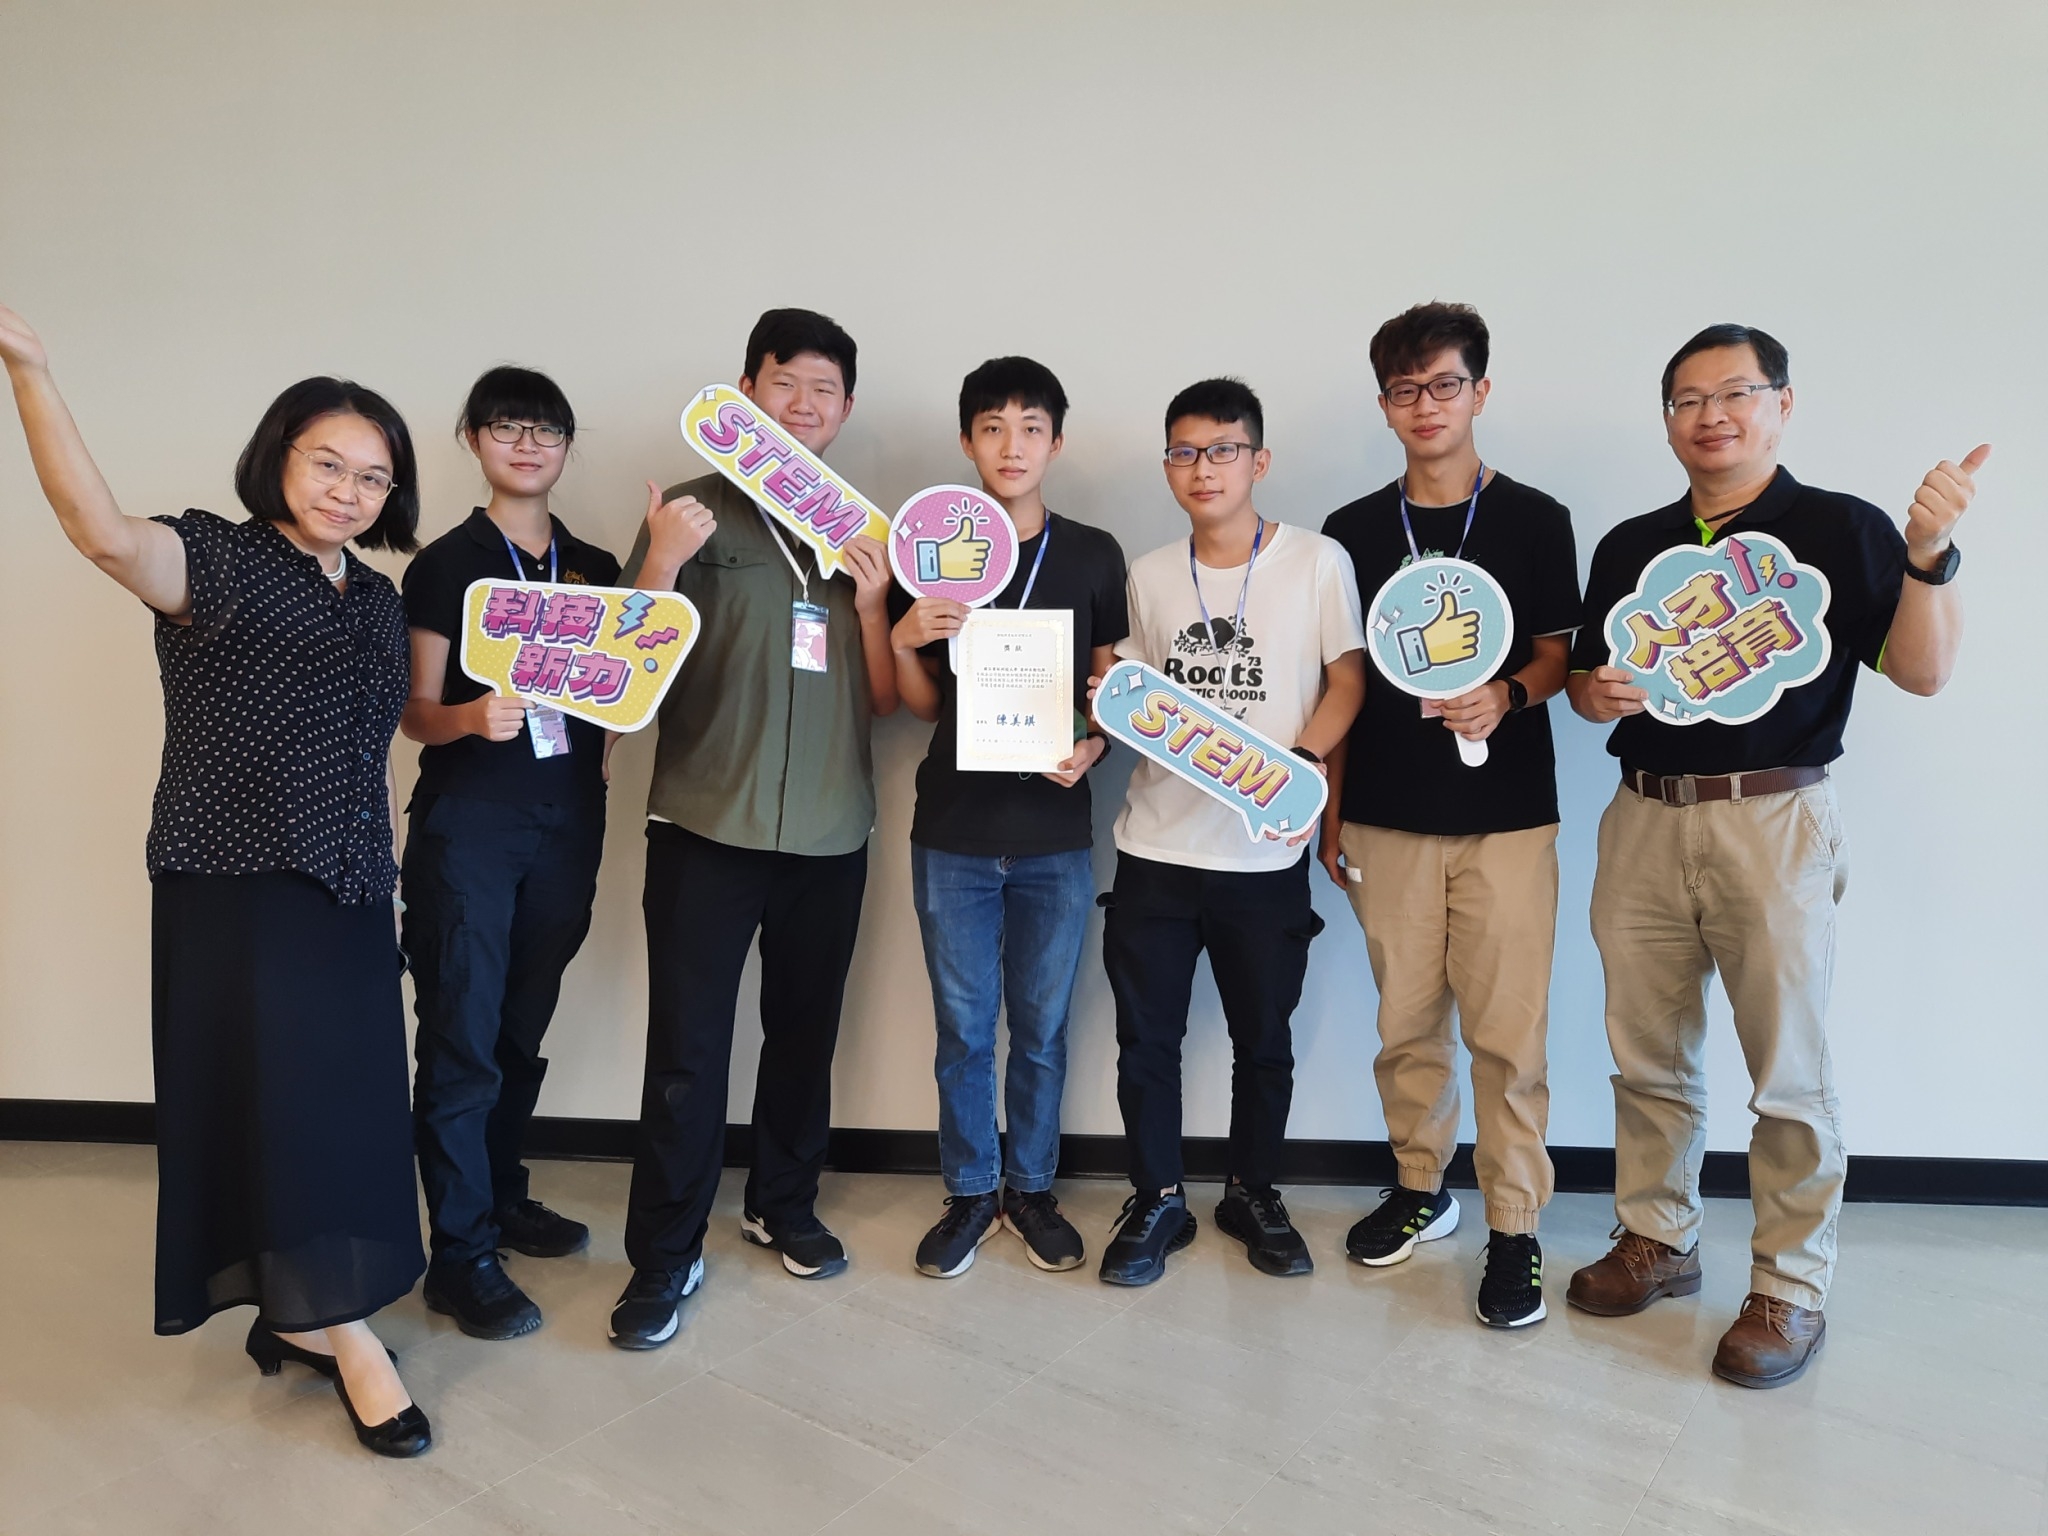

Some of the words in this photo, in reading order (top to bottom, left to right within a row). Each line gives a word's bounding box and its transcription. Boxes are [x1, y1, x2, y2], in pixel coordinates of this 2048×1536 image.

[699, 402, 868, 549] STEM
[483, 587, 605, 647] 科技
[1626, 572, 1737, 669] 人才
[1668, 599, 1804, 700] 培育
[511, 643, 633, 704] 新力
[1164, 658, 1263, 687] Roots
[1247, 656, 1262, 666] 73
[1131, 692, 1290, 808] STEM
